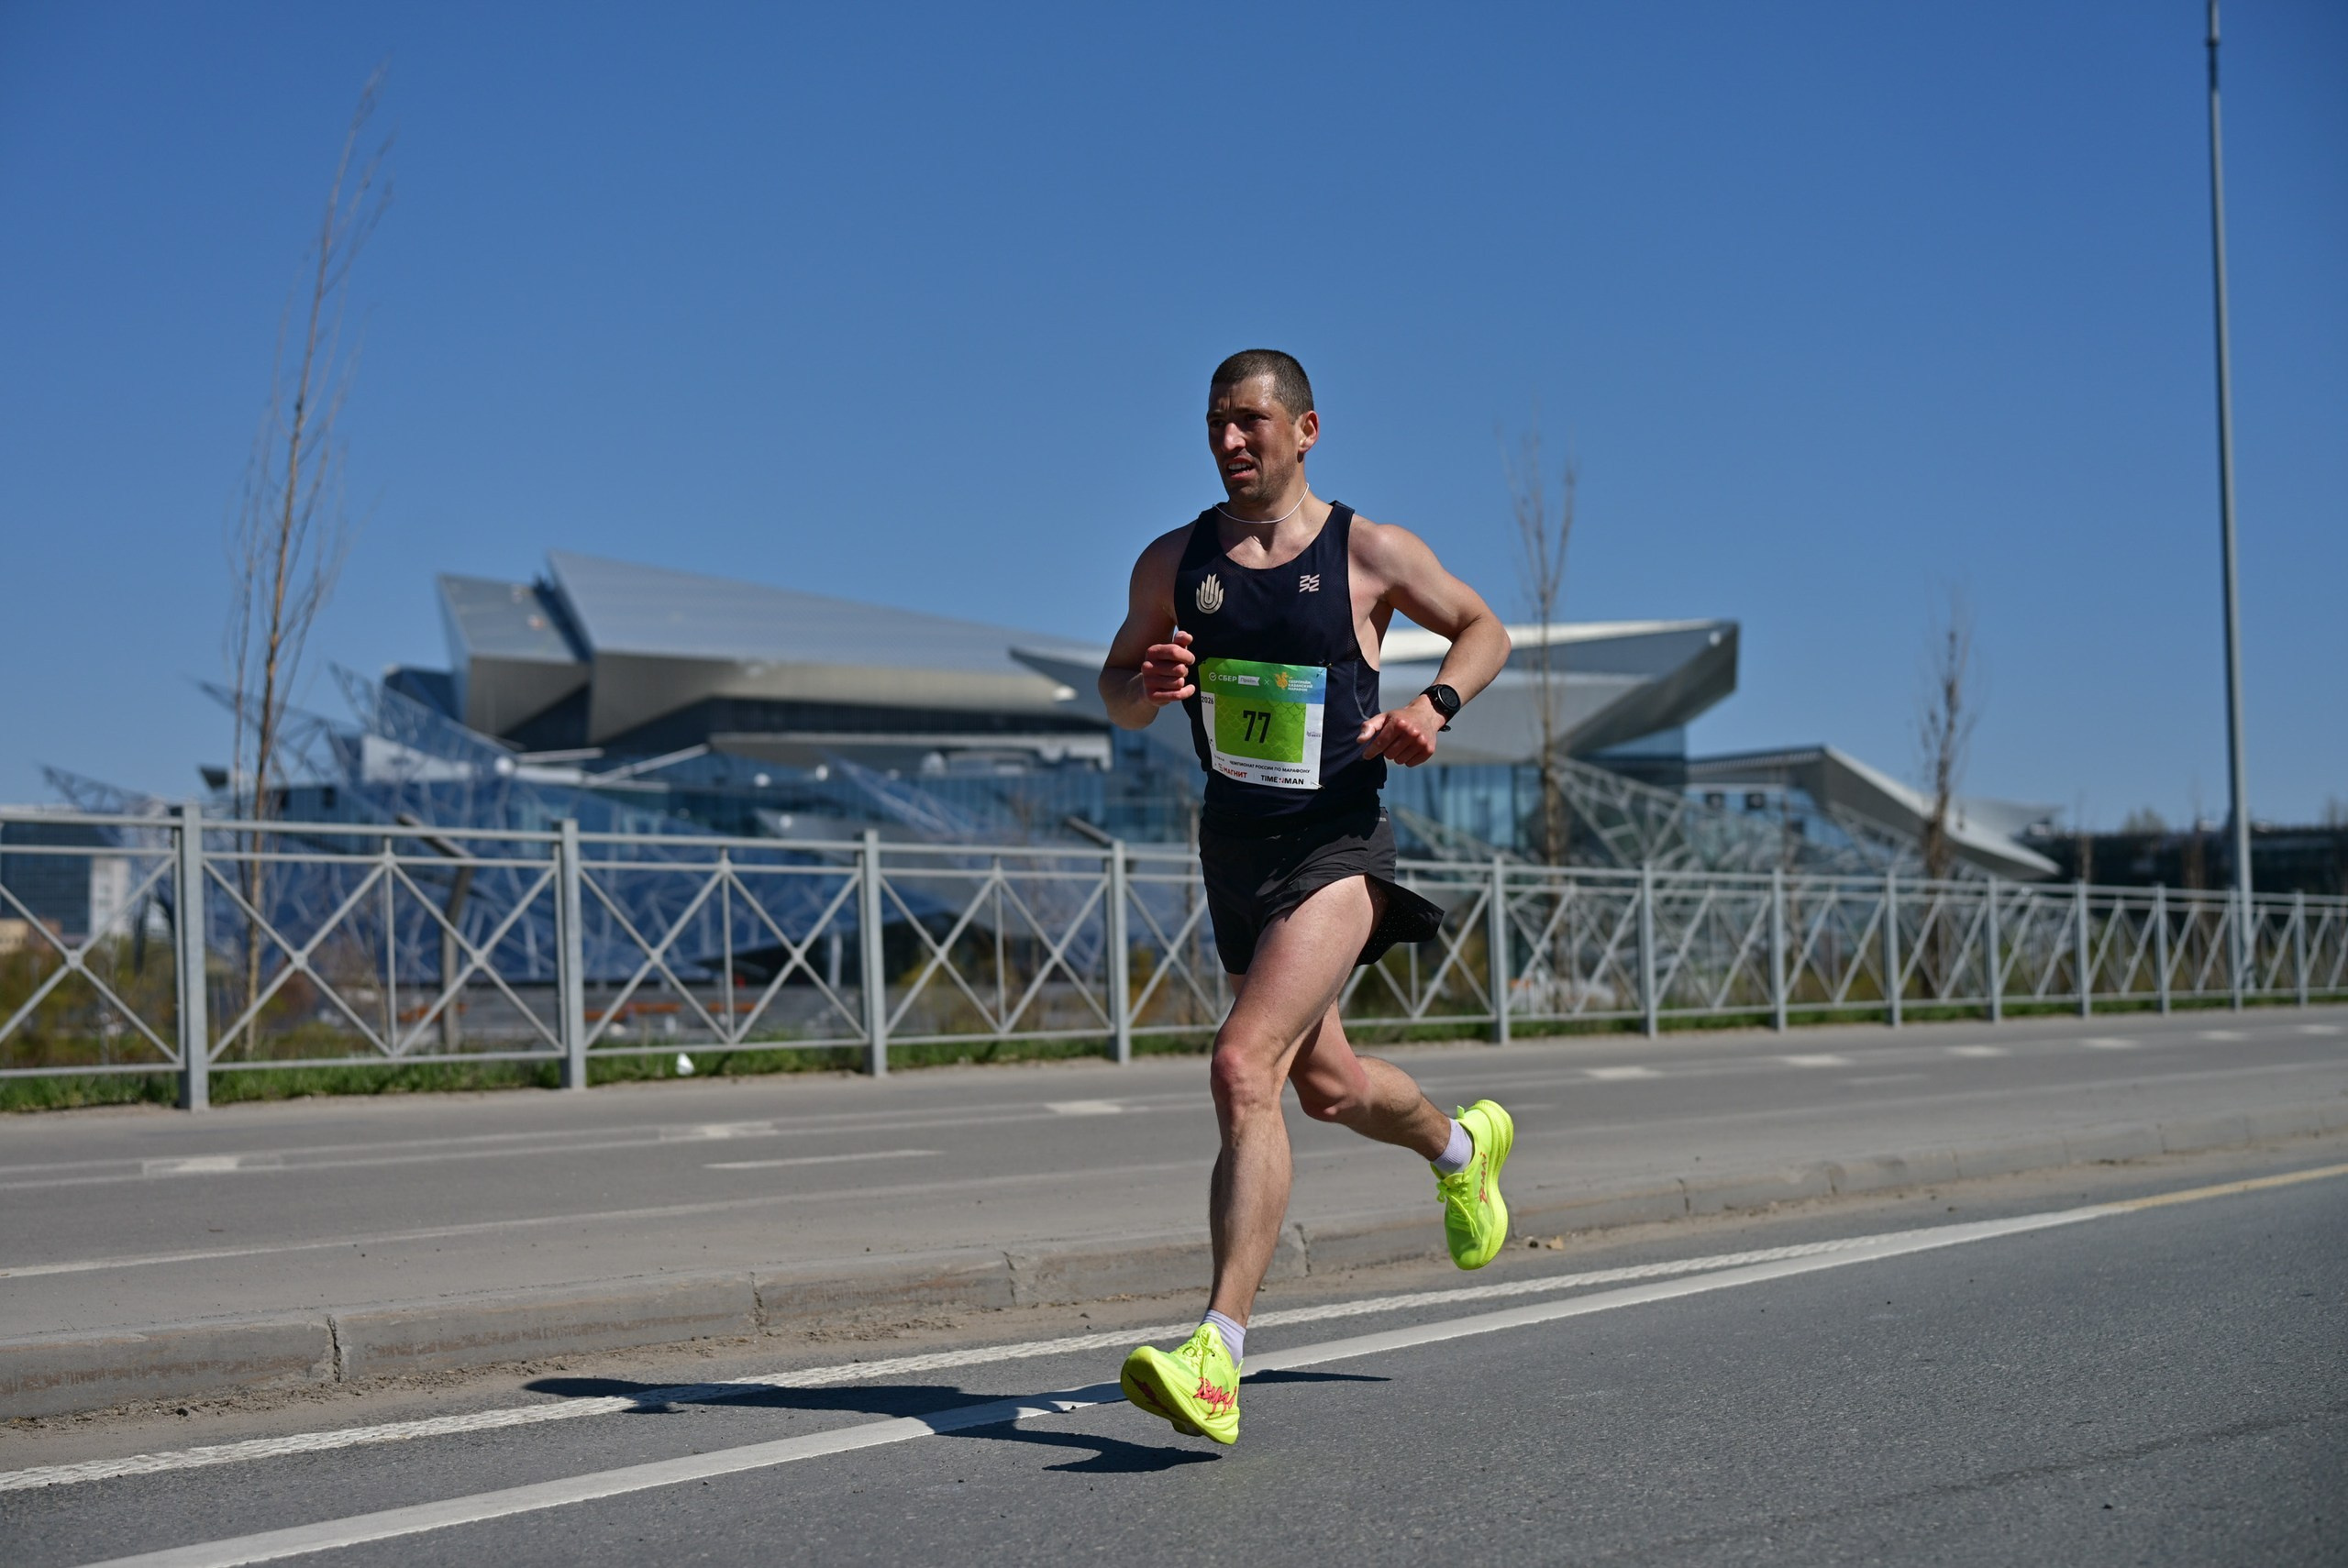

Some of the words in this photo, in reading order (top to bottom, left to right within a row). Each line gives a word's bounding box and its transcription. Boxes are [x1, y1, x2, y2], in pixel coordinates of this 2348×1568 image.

[1201, 696, 1214, 705] 2026
[1243, 710, 1271, 744] 77
[1229, 760, 1255, 768] ЧЕМПИОНАТ
[1223, 767, 1247, 778] МАГНИТ
